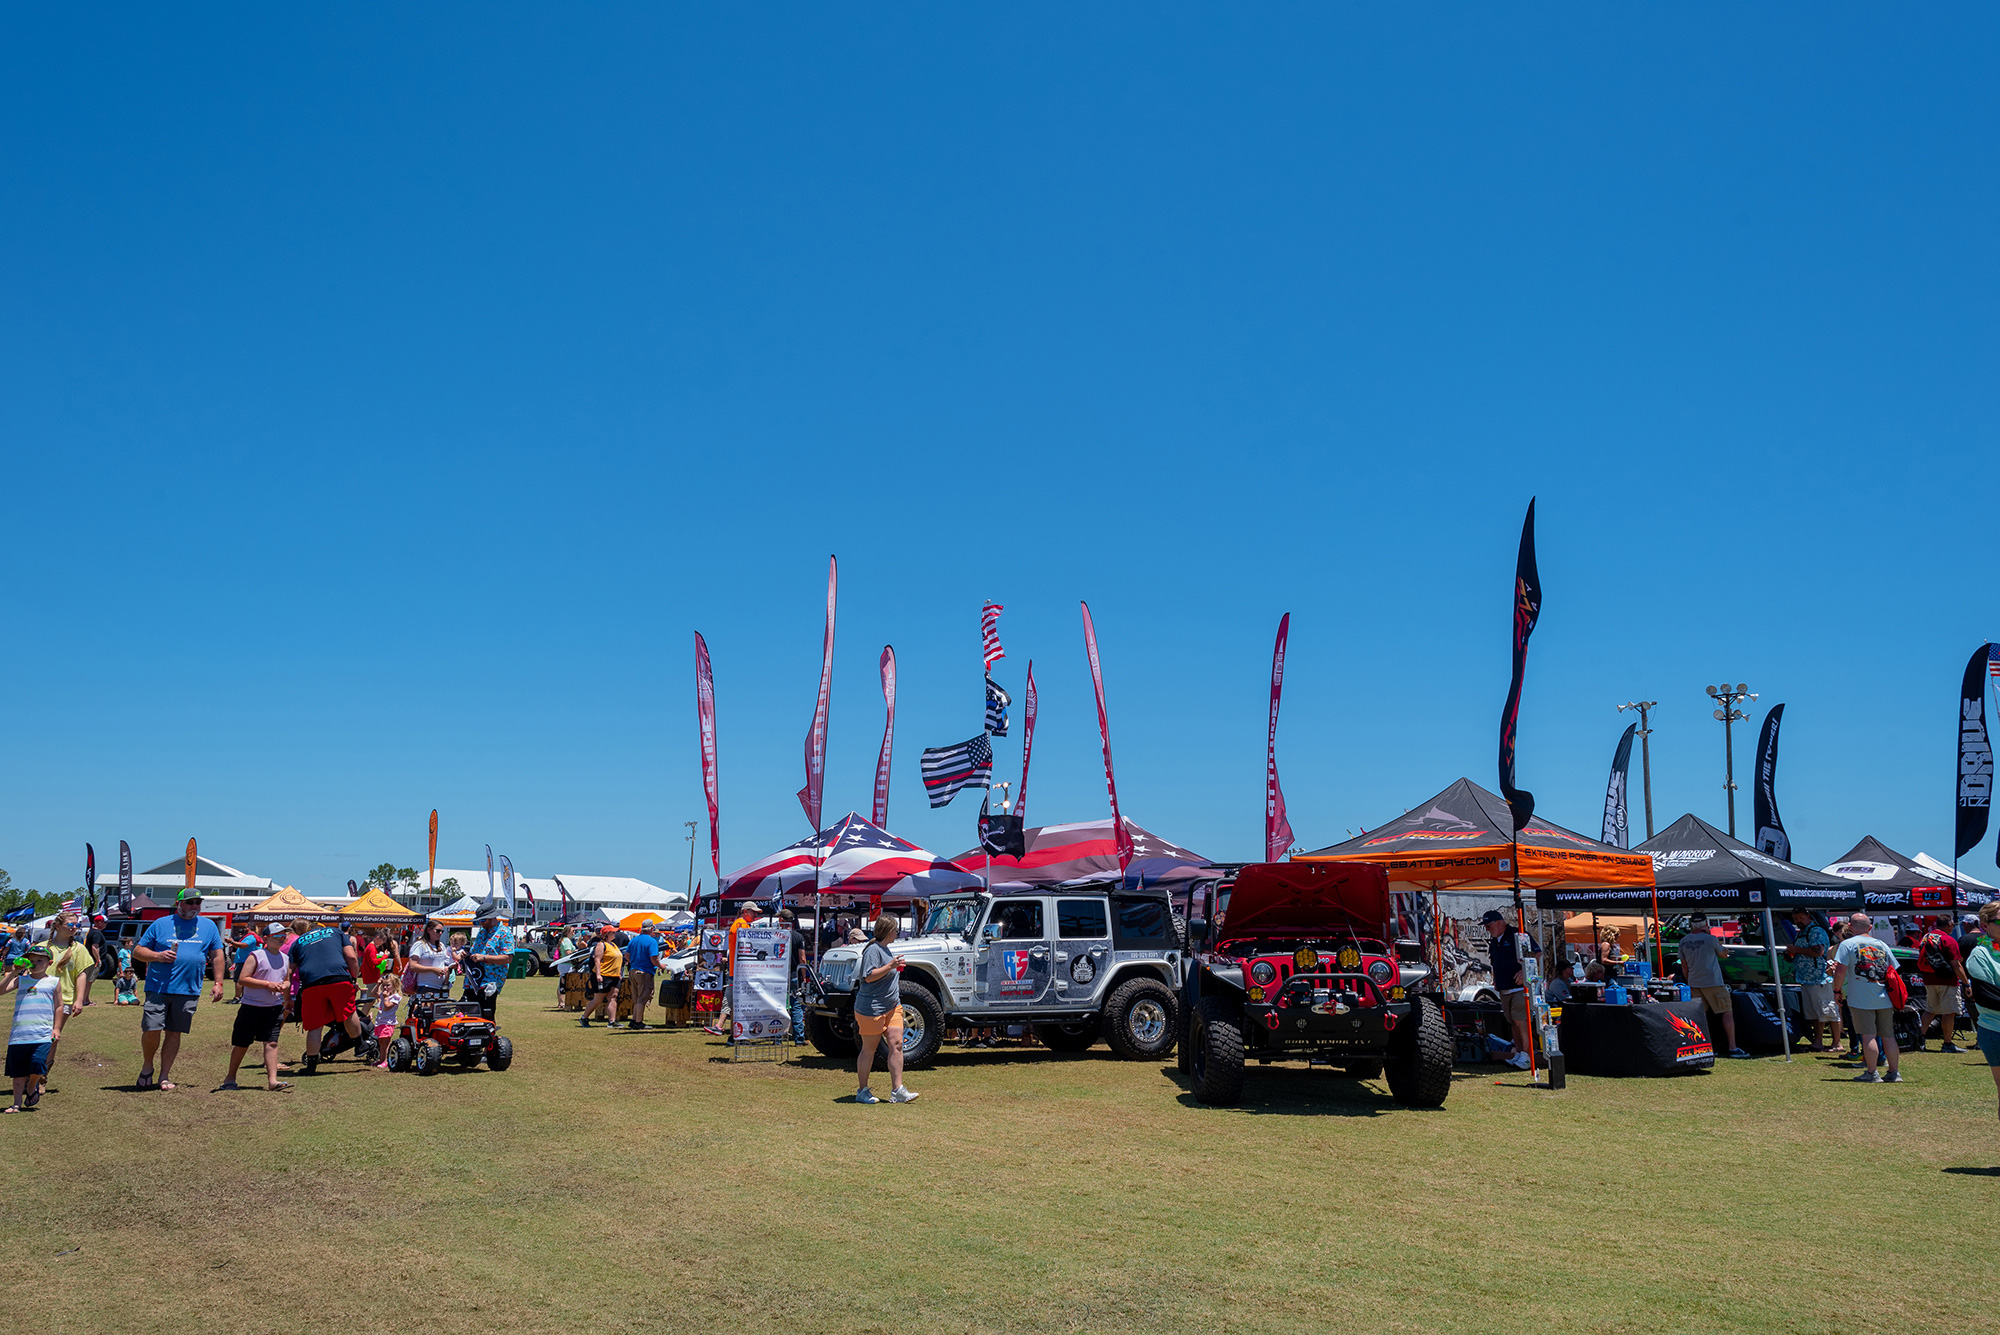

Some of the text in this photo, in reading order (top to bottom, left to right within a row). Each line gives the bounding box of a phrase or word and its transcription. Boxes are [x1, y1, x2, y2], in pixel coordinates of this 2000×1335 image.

[1267, 699, 1279, 817] ATTITUDE
[1762, 759, 1772, 781] THE
[1616, 809, 1625, 828] USA
[1524, 848, 1568, 860] EXTREME
[1569, 852, 1598, 863] POWER
[1602, 855, 1614, 864] ON
[1668, 849, 1717, 858] WARRIOR
[121, 874, 129, 895] NINE
[297, 928, 334, 944] COSTA
[747, 930, 772, 940] SHIELDS
